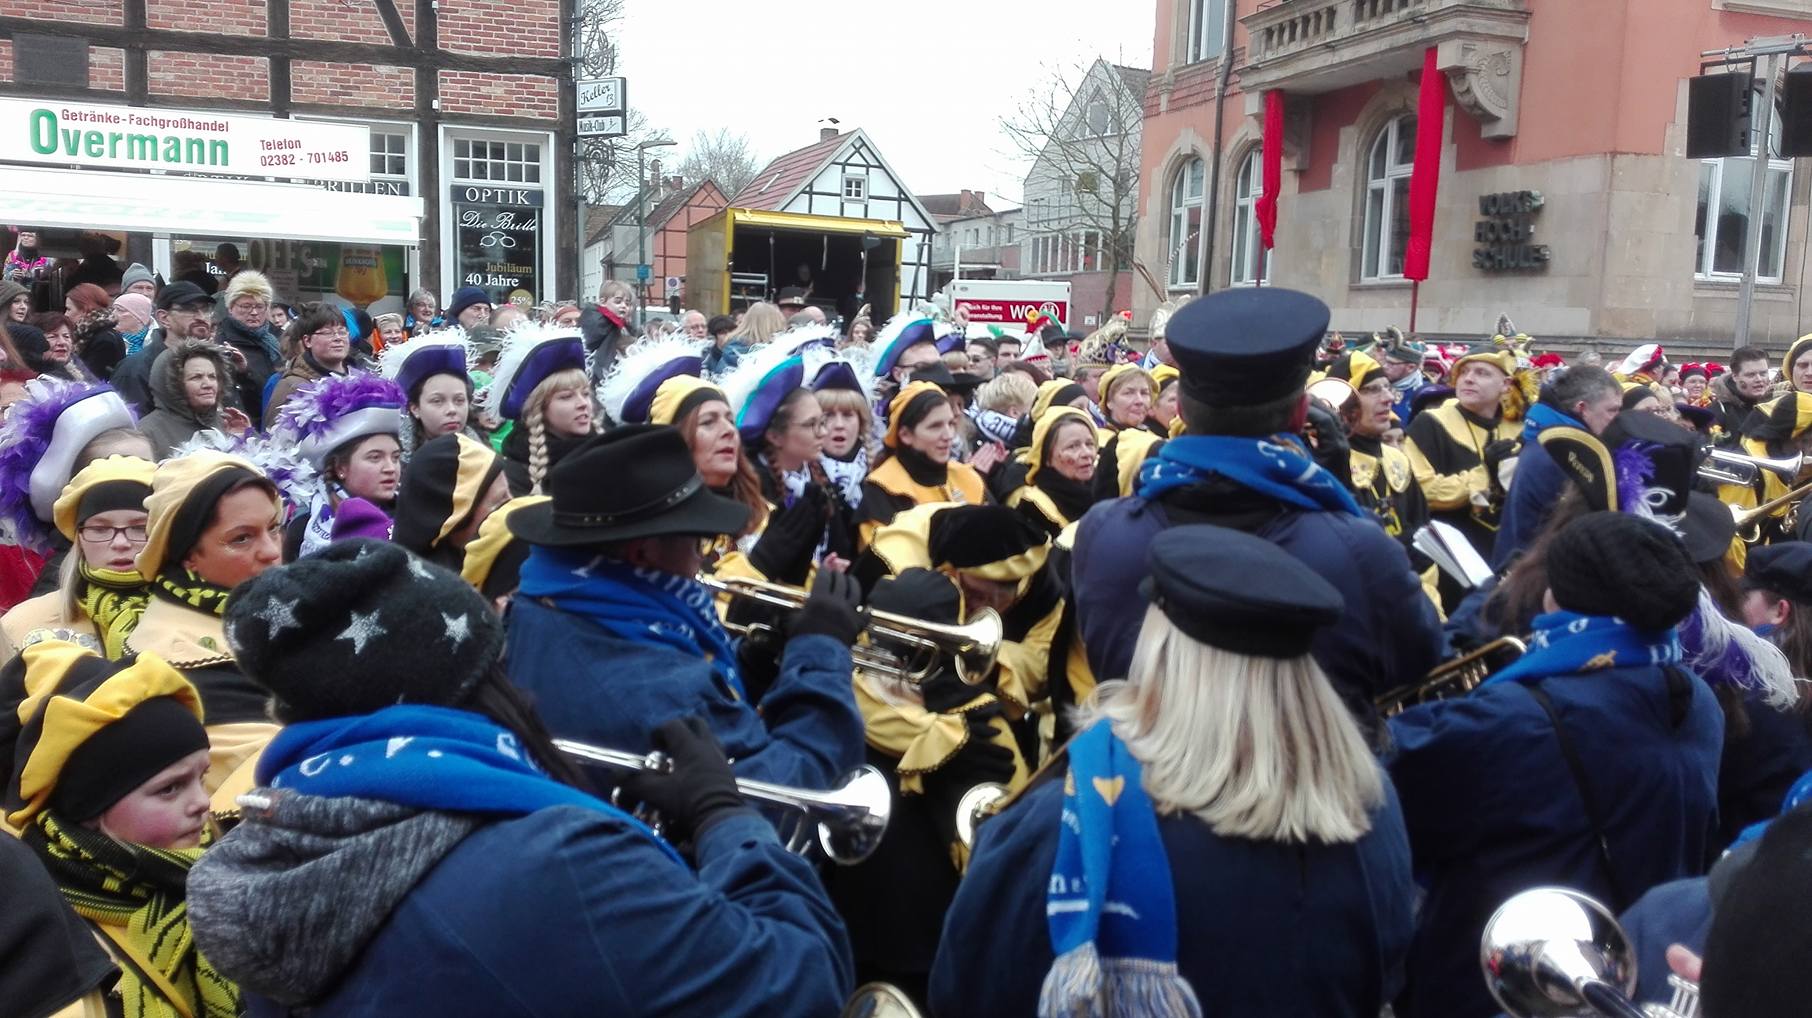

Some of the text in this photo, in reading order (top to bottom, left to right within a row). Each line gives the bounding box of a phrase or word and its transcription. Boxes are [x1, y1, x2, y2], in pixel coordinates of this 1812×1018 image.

[581, 84, 610, 105] Keller
[30, 108, 229, 166] Overmann
[260, 137, 302, 151] Telefon
[260, 154, 296, 167] 02382
[307, 151, 349, 163] 701485
[465, 187, 531, 205] OPTIK
[460, 210, 537, 231] Die Brille
[485, 262, 533, 274] Jubiläum
[465, 273, 520, 287] 40 Jahre
